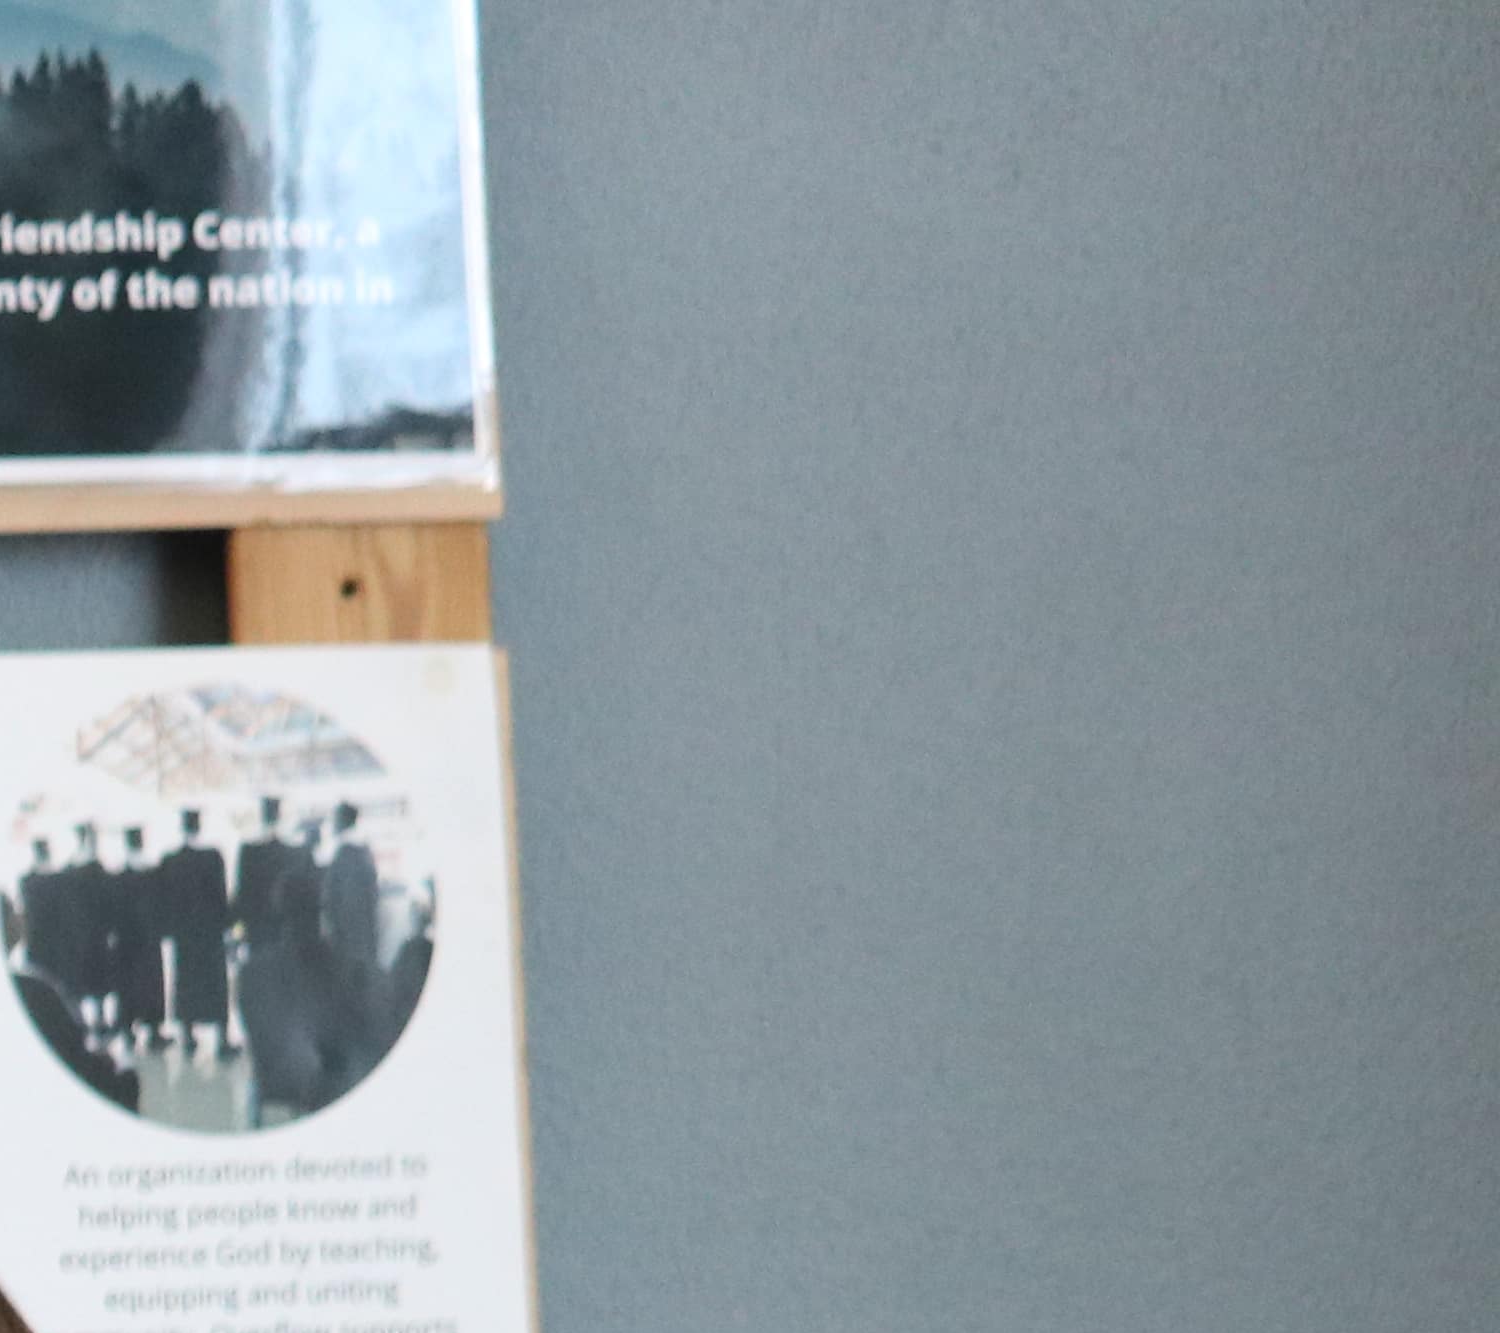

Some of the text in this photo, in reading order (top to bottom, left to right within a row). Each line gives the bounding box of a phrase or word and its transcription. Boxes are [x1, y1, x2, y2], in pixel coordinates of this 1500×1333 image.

[72, 272, 120, 311] of
[125, 271, 200, 310] the
[208, 268, 345, 319] nation
[64, 1155, 427, 1197] An organization devoted to
[77, 1193, 418, 1231] helping people know and
[58, 1247, 208, 1275] experience
[215, 1239, 273, 1265] God
[278, 1241, 312, 1267] by
